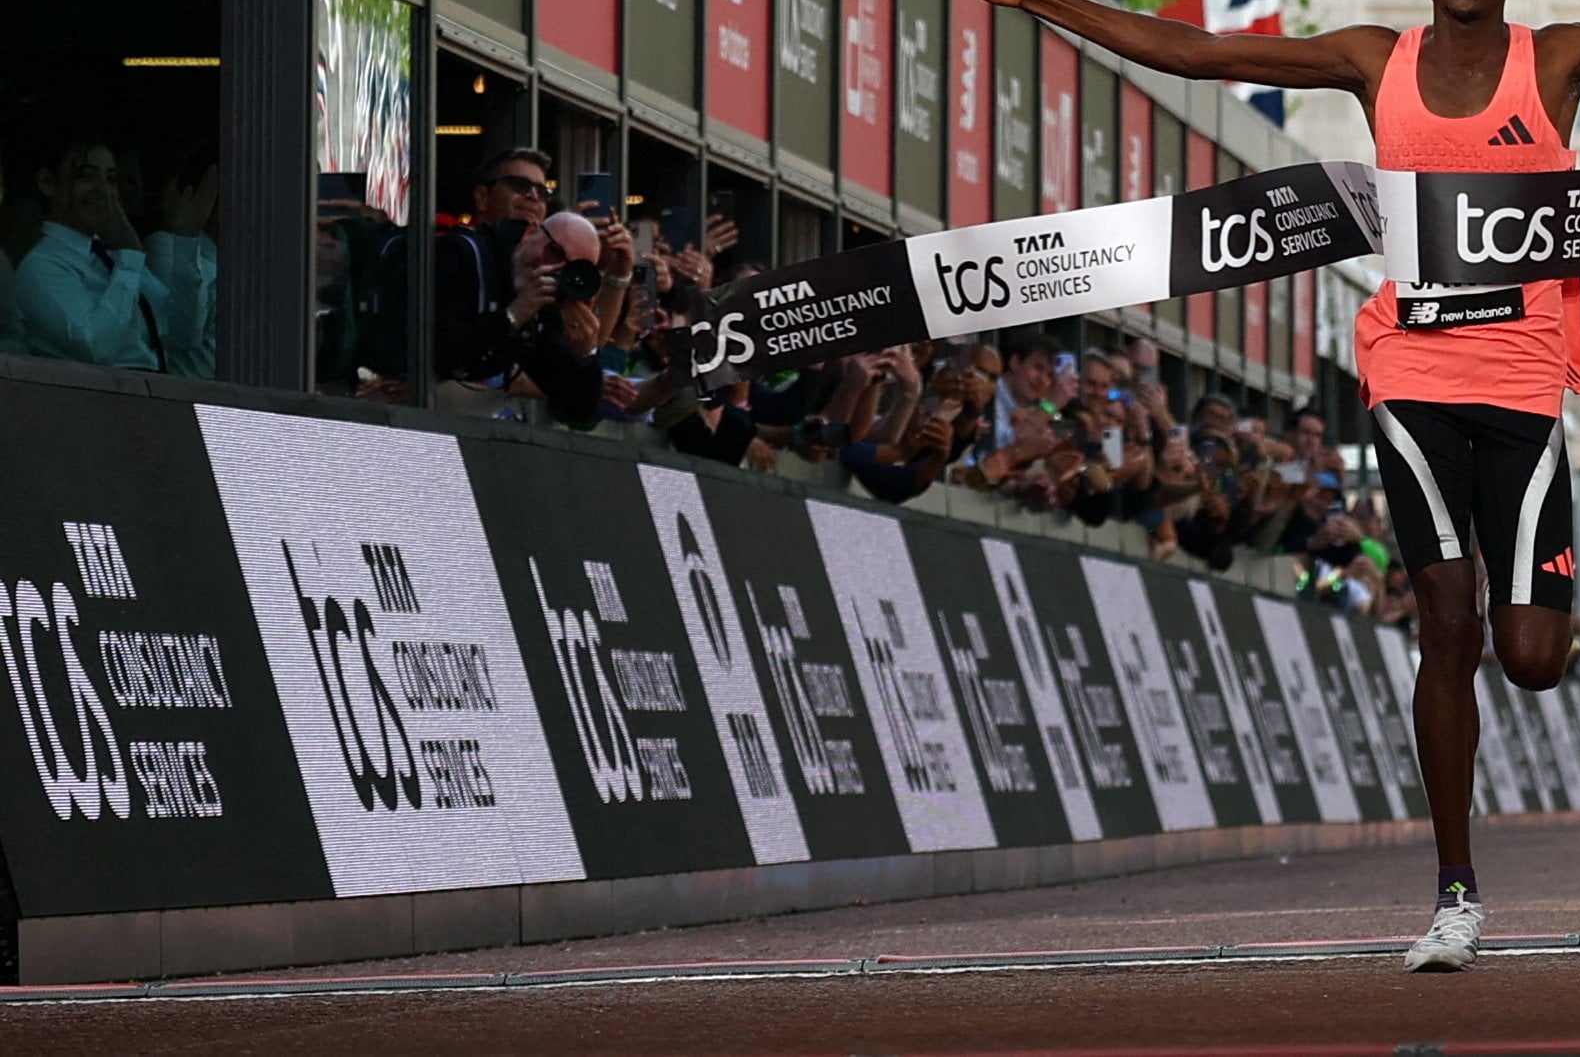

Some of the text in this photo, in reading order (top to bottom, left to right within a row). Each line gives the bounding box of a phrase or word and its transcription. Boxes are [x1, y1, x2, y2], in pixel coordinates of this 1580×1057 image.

[1265, 185, 1300, 209] TATA
[1274, 201, 1341, 232] CONSULTANCY
[1013, 231, 1066, 255] TATA
[1201, 206, 1275, 273] tcs
[1280, 227, 1332, 257] SERVICES
[1456, 191, 1555, 264] tcs
[934, 252, 1011, 316] tcs
[1016, 243, 1136, 280] CONSULTANCY
[1019, 274, 1092, 304] SERVICES
[753, 280, 817, 310] TATA
[760, 285, 893, 332] CONSULTANCY
[1440, 311, 1464, 322] new
[1465, 306, 1513, 320] balance
[766, 317, 858, 356] SERVICES
[360, 544, 421, 612] TATA
[99, 630, 233, 708] CONSULTANCY
[281, 538, 423, 812] tcs
[392, 641, 499, 712] CONSULTANCY
[528, 556, 644, 804] tcs
[129, 742, 223, 818] SERVICES
[420, 739, 496, 808] SERVICES
